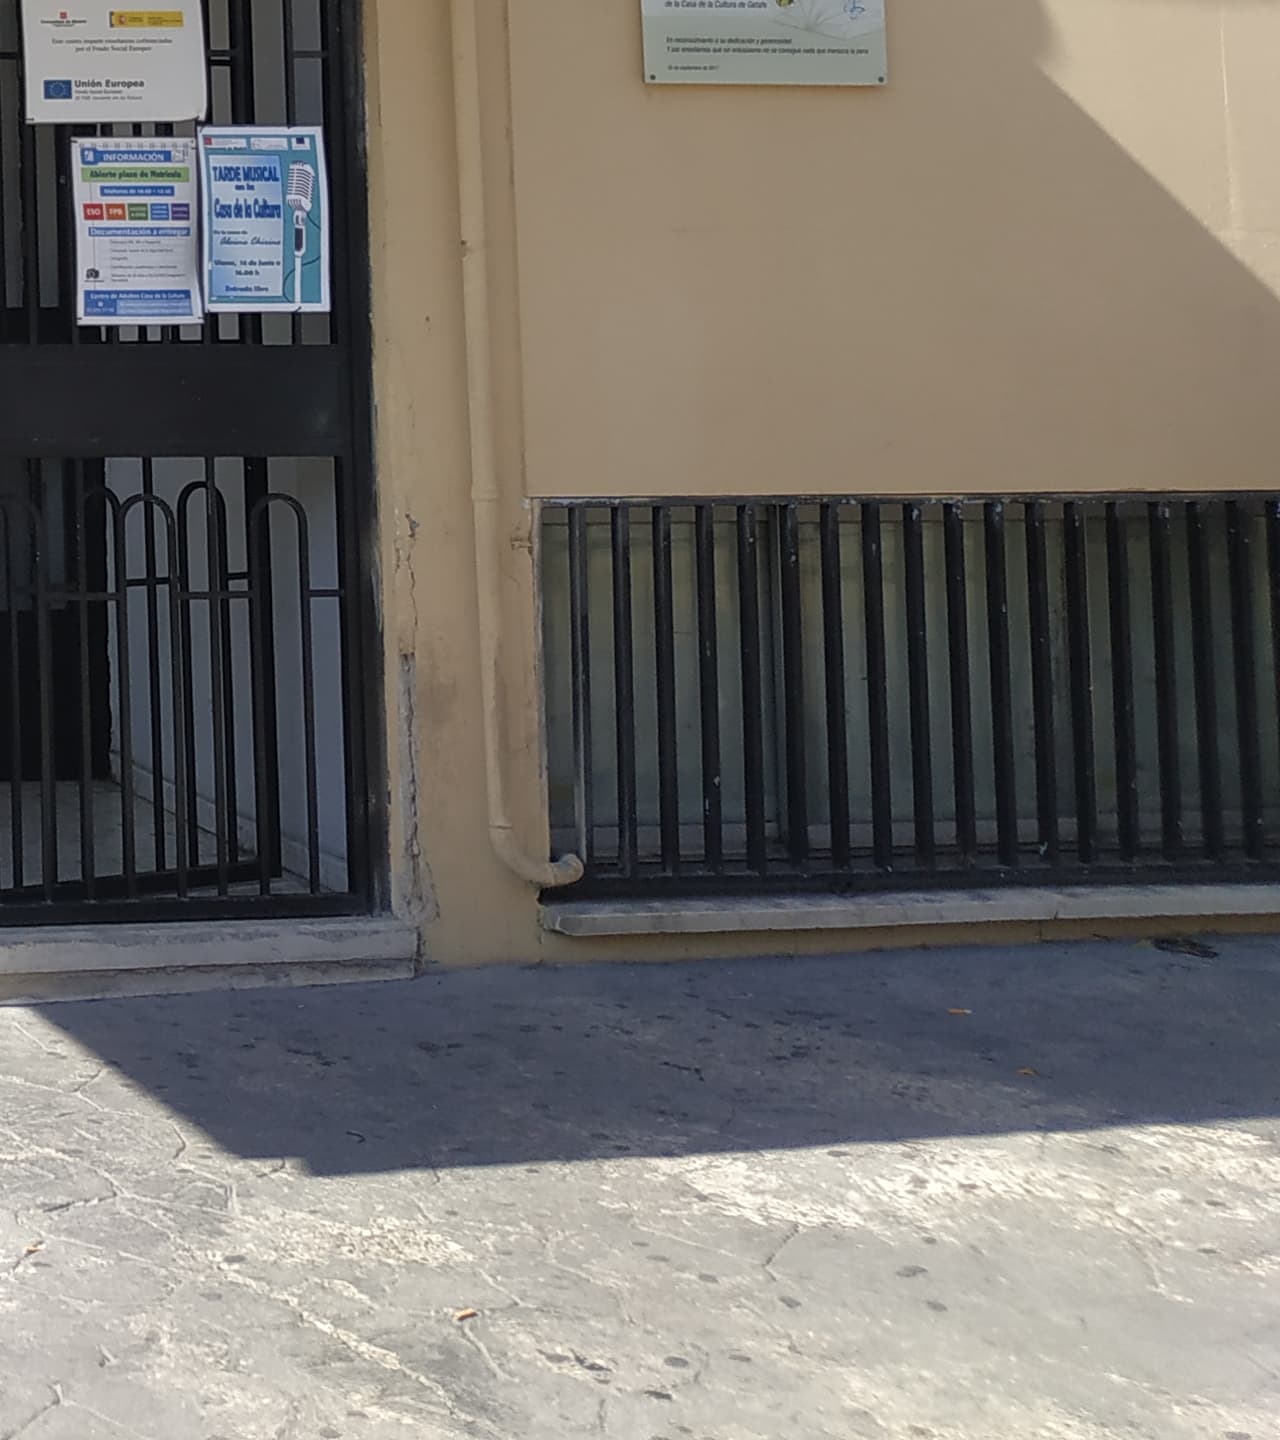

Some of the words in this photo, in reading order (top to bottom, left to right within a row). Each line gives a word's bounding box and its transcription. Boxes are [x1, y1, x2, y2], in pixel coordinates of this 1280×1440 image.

[74, 79, 102, 88] Unión
[105, 80, 144, 89] Europea
[103, 151, 164, 161] INFORMACIÓN
[212, 166, 241, 181] TARDE
[243, 166, 279, 181] MUSICAL
[215, 199, 231, 219] Casa
[234, 199, 243, 219] de
[245, 199, 252, 219] la
[254, 199, 281, 219] Cultura
